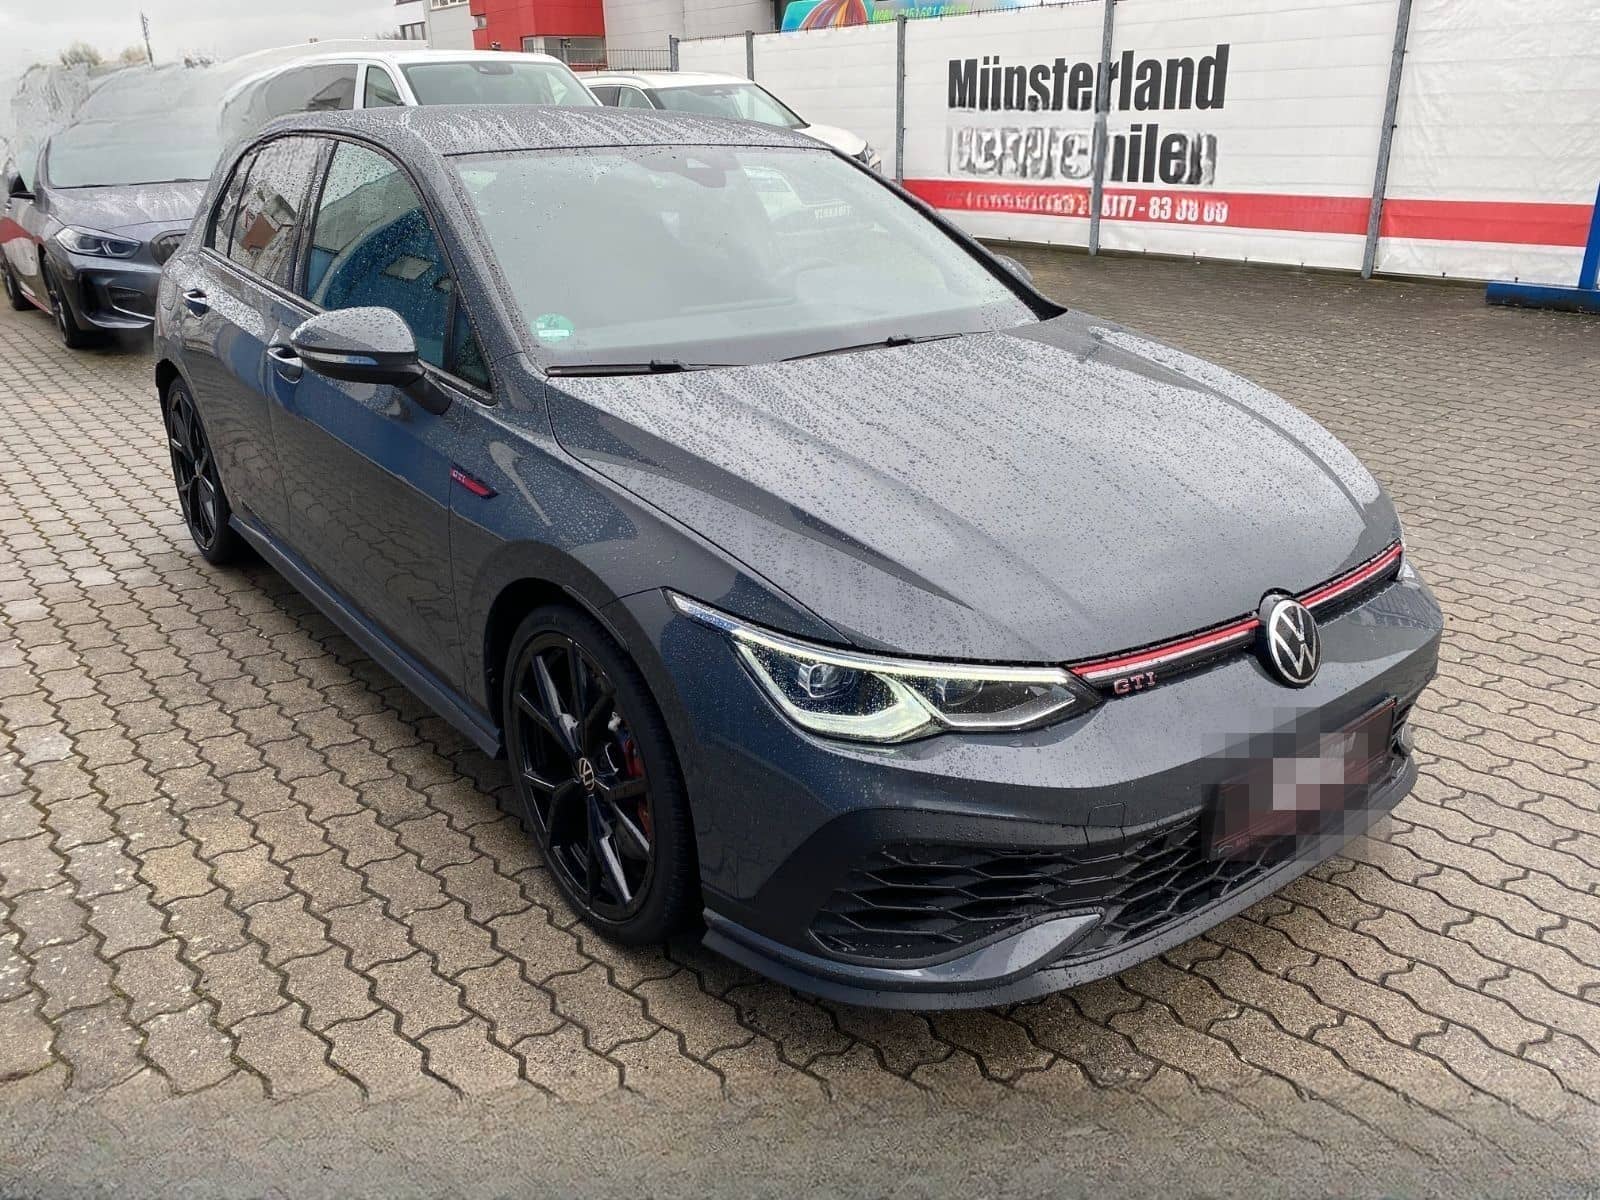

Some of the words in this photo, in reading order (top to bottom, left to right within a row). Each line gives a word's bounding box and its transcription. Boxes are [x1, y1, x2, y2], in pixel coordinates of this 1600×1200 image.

[948, 44, 1230, 112] Münsterland
[1148, 196, 1172, 220] 83
[1113, 671, 1157, 695] GTI
